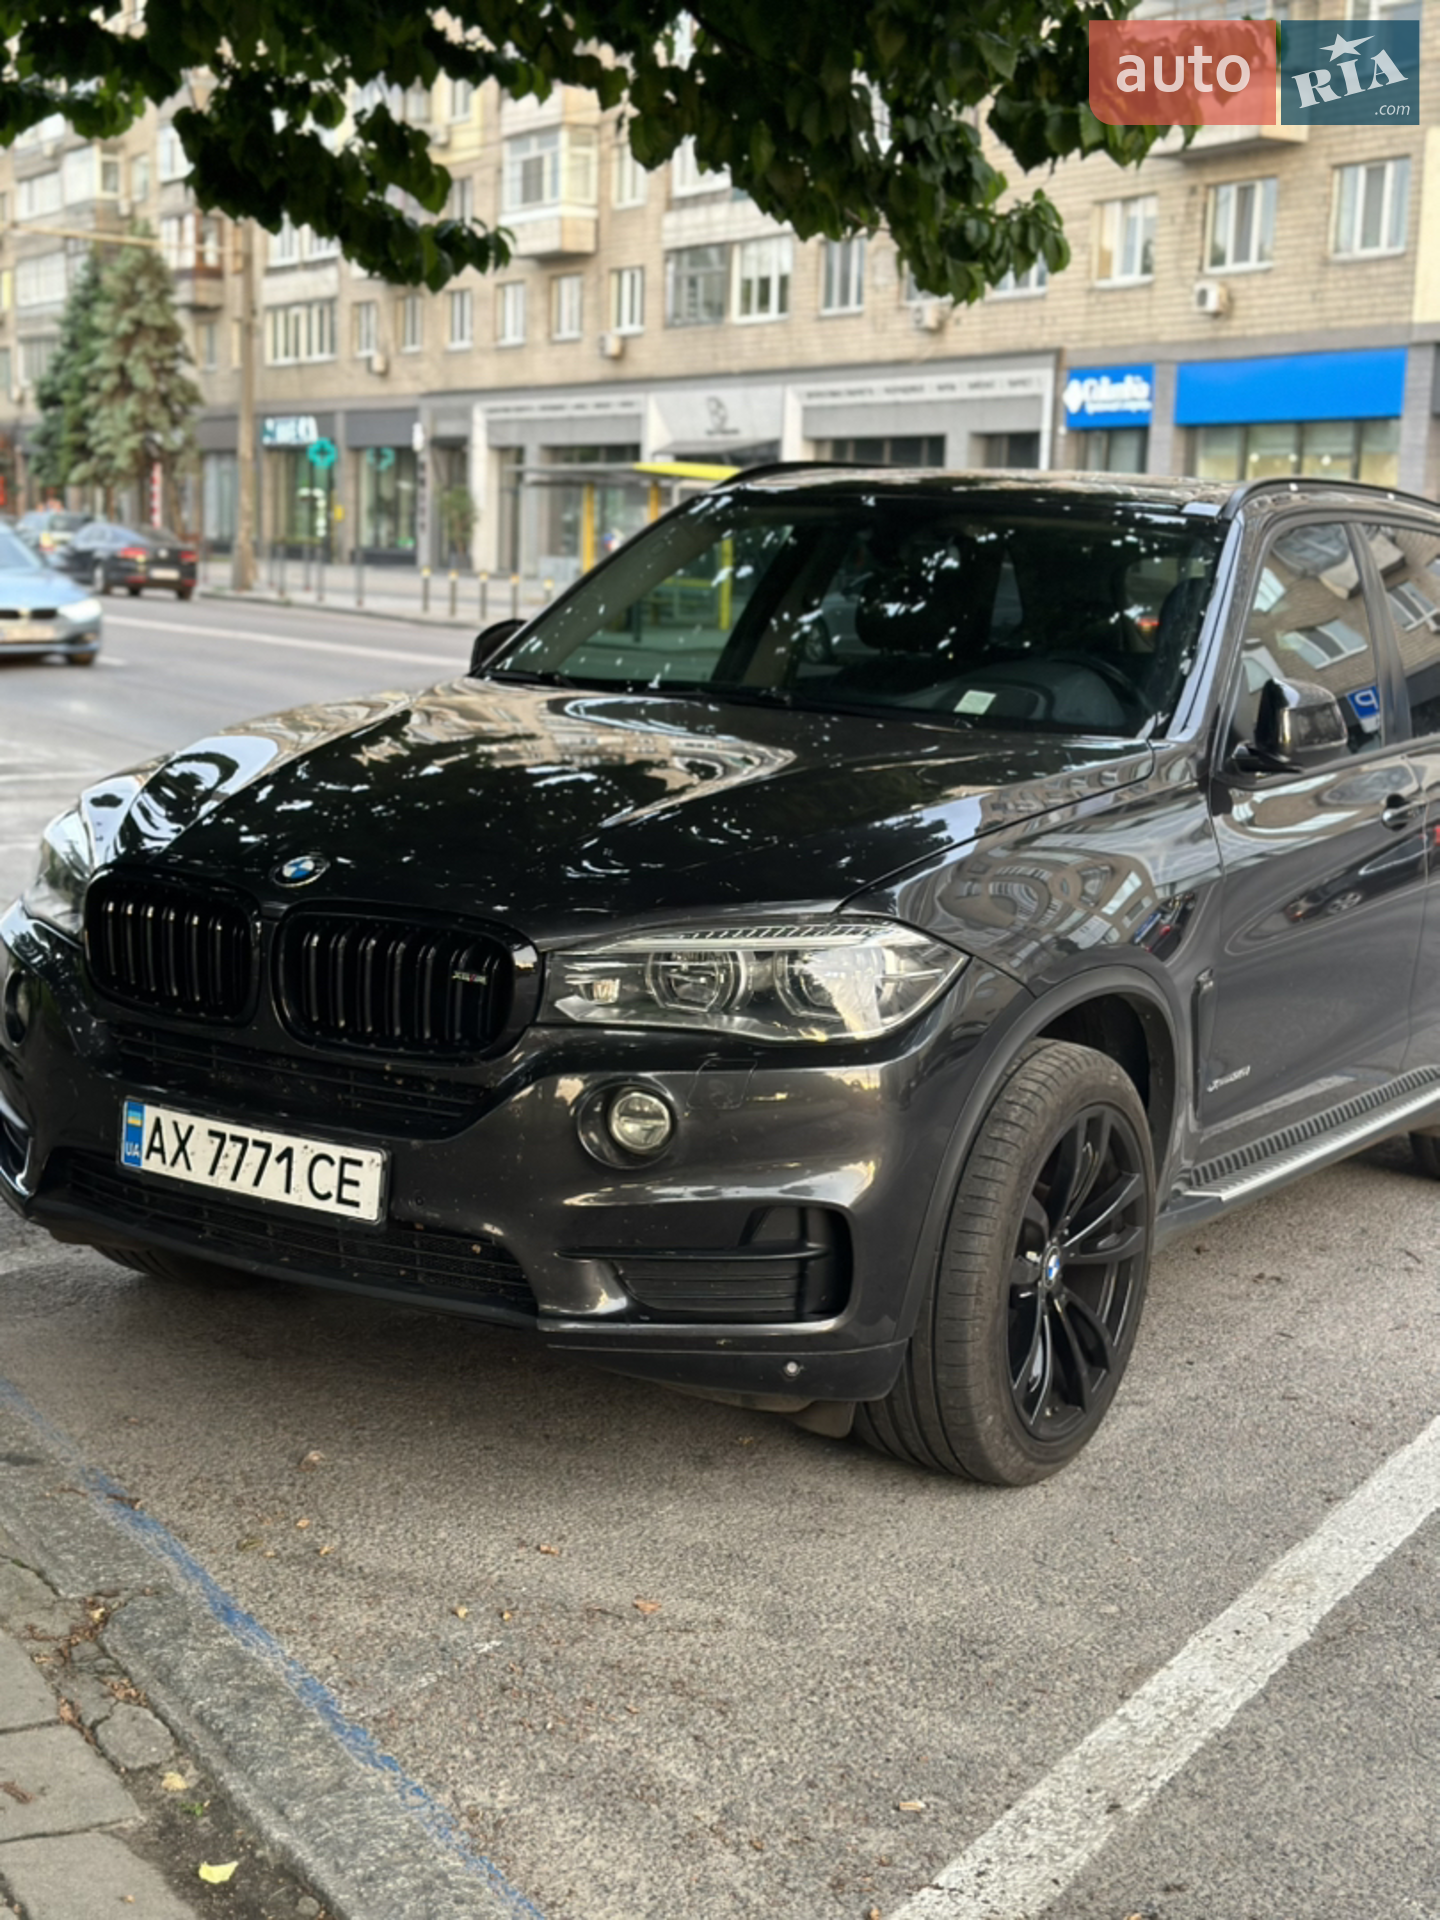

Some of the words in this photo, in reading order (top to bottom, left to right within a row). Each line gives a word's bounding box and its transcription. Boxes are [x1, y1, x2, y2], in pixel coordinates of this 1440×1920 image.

[125, 1142, 141, 1159] UA
[145, 1116, 195, 1172] AX
[207, 1128, 294, 1195] 7771
[307, 1152, 364, 1209] CE
